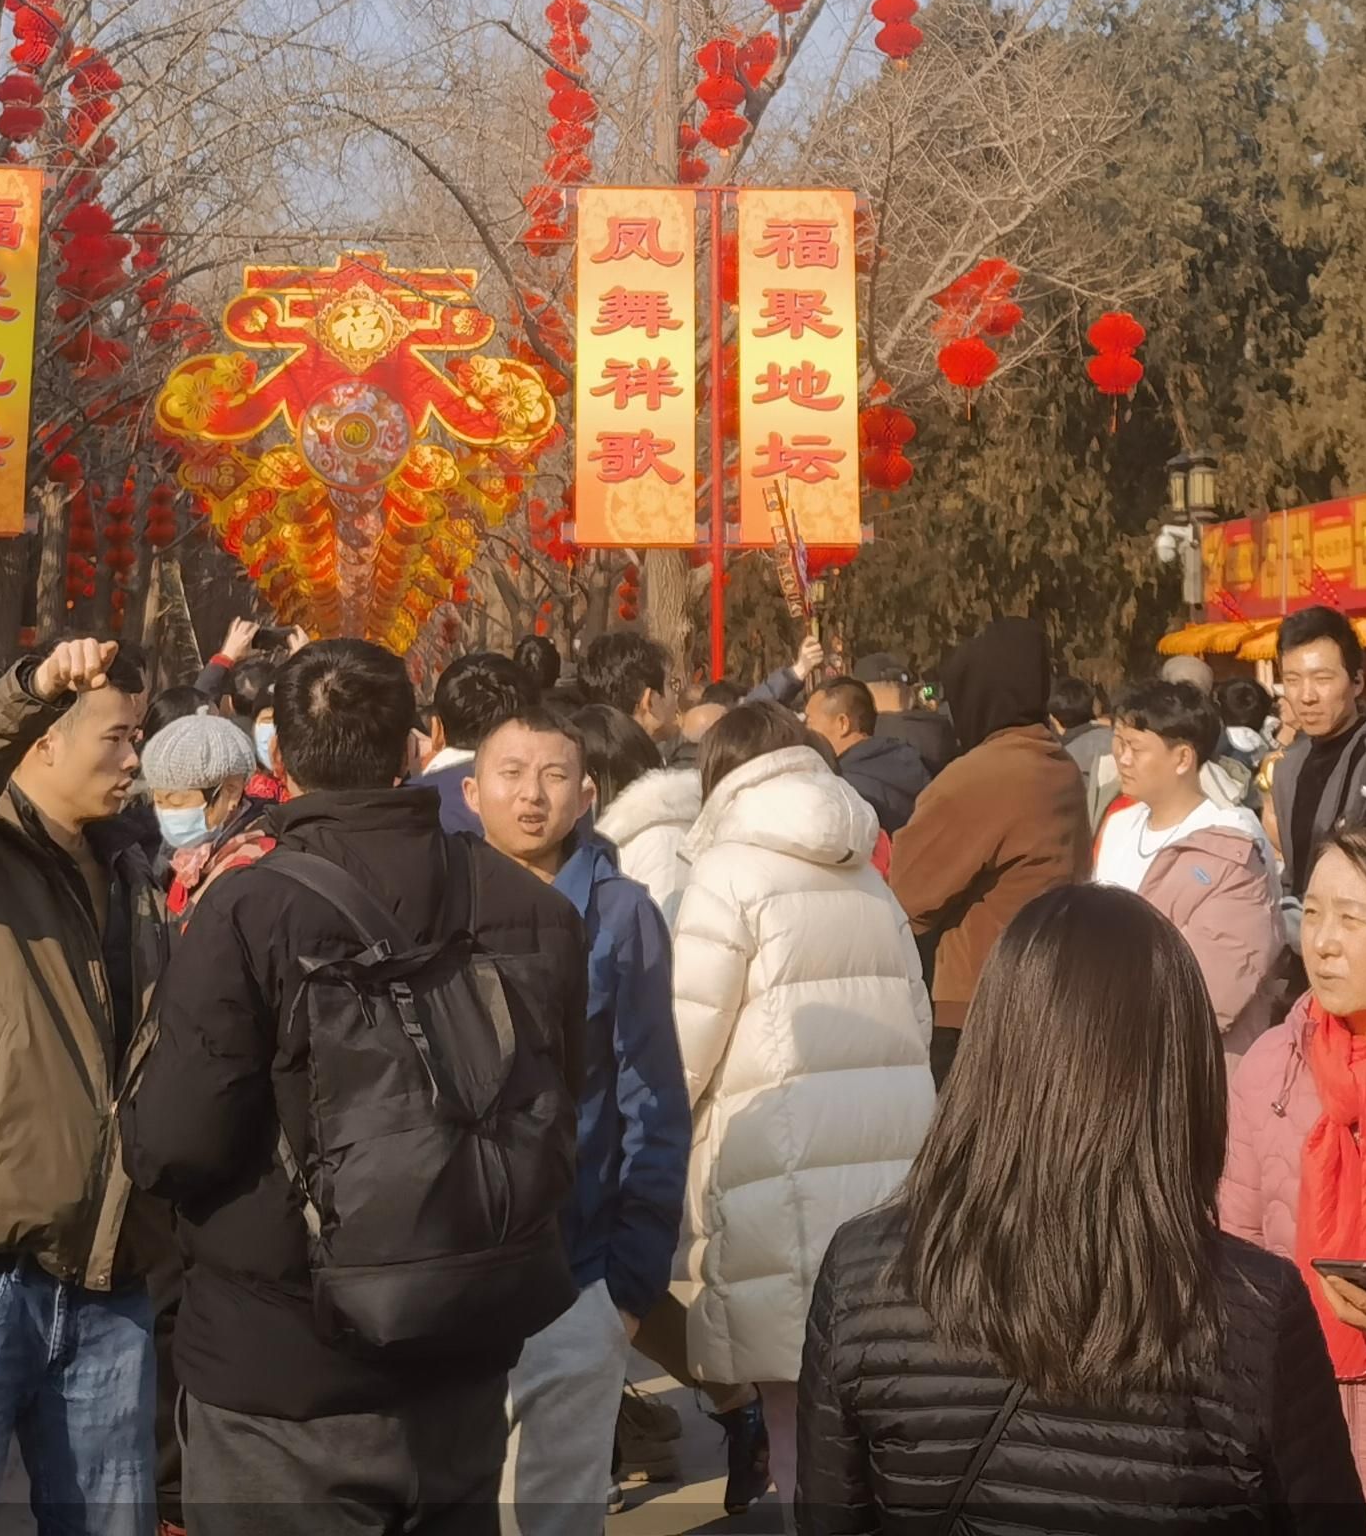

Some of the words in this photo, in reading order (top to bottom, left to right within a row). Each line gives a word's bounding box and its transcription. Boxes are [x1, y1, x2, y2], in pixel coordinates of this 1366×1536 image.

[588, 217, 684, 484] 凤舞祥歌
[751, 218, 846, 484] 福聚地坛
